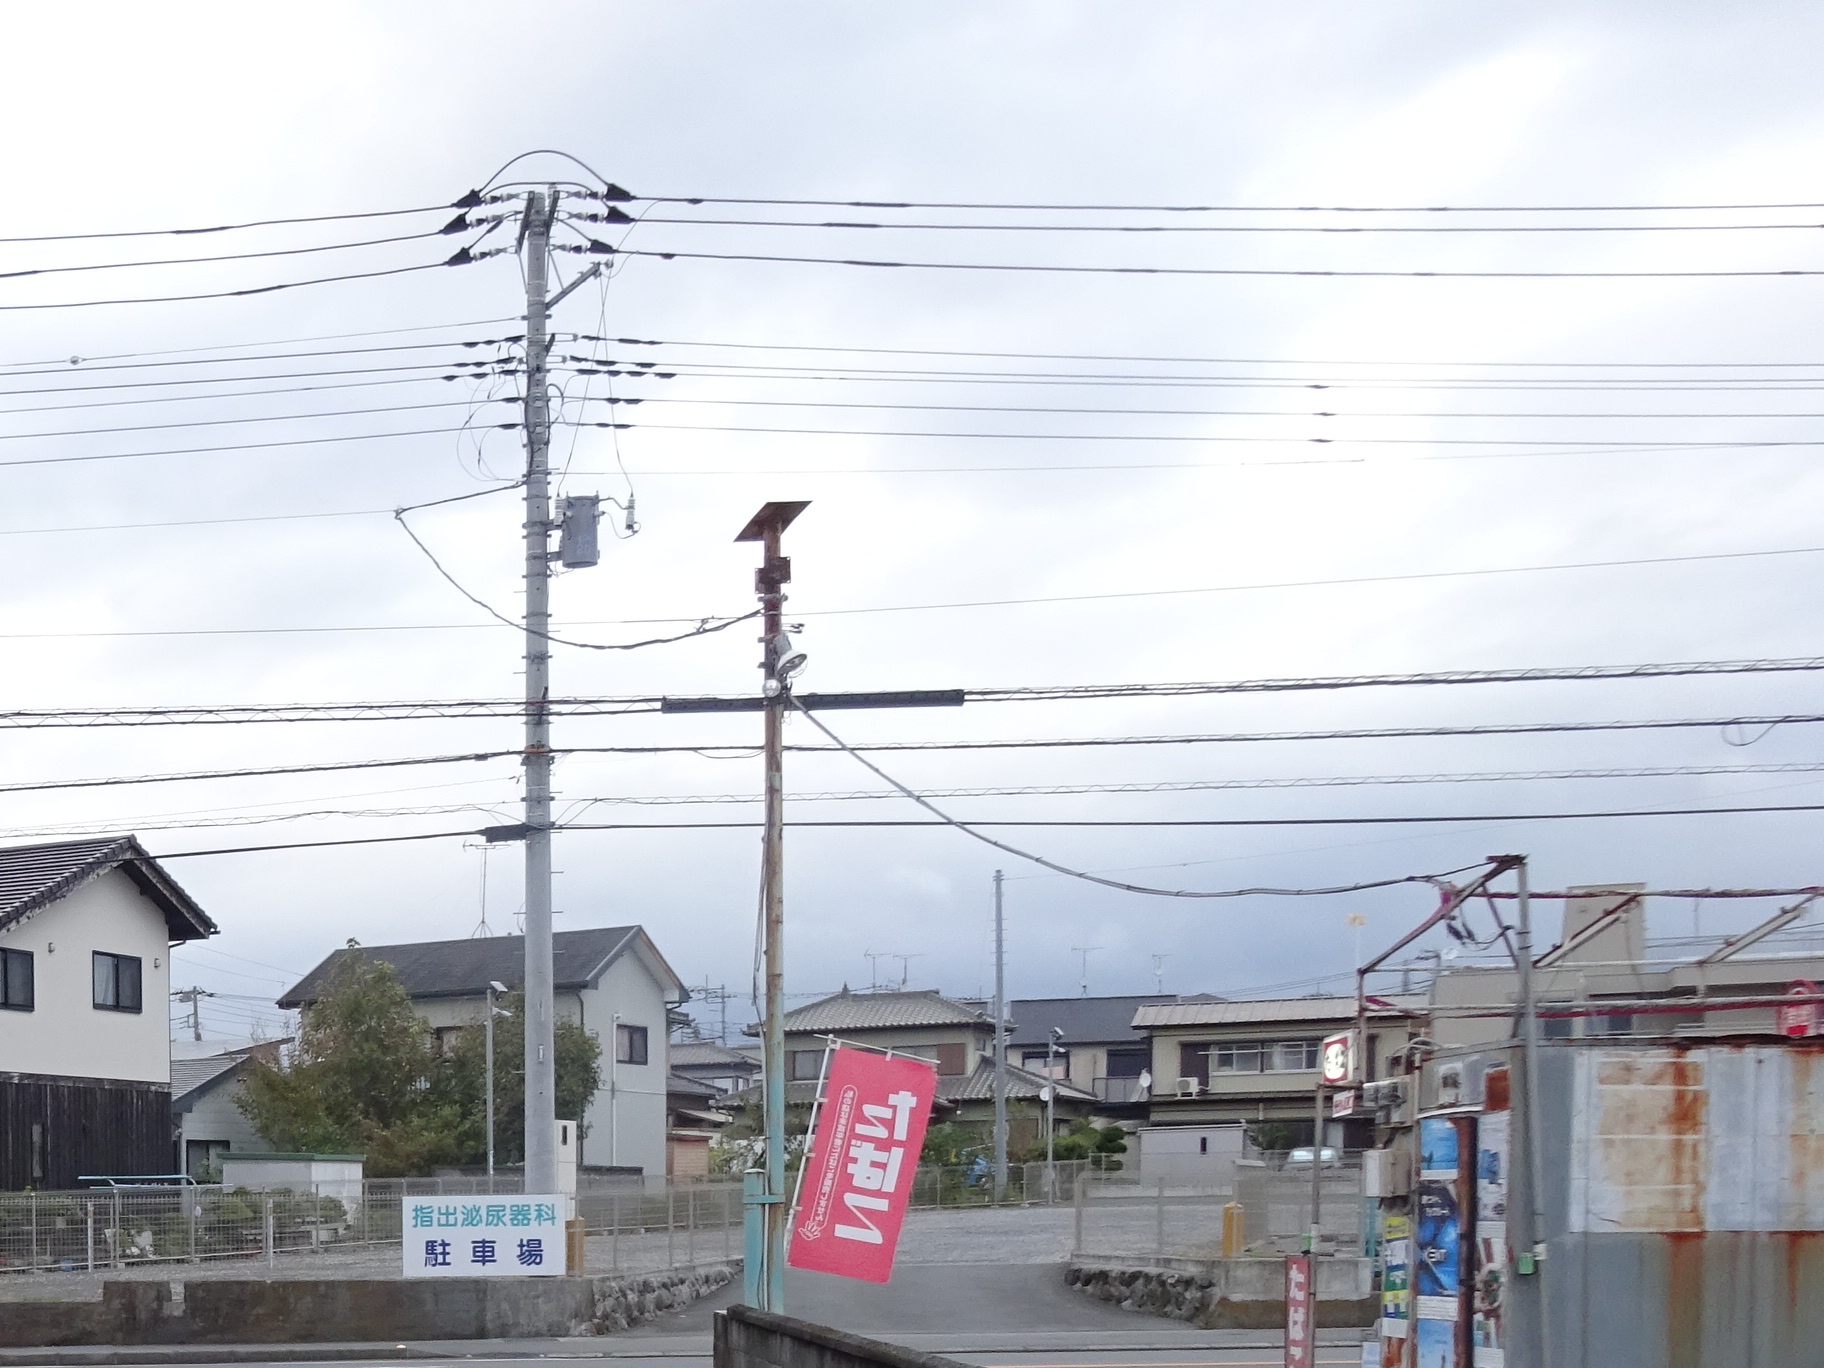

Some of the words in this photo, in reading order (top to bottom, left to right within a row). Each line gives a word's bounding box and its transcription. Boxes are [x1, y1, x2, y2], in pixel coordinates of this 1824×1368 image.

[412, 1203, 556, 1228] 指出泌尿器科
[424, 1238, 544, 1267] 駐車場
